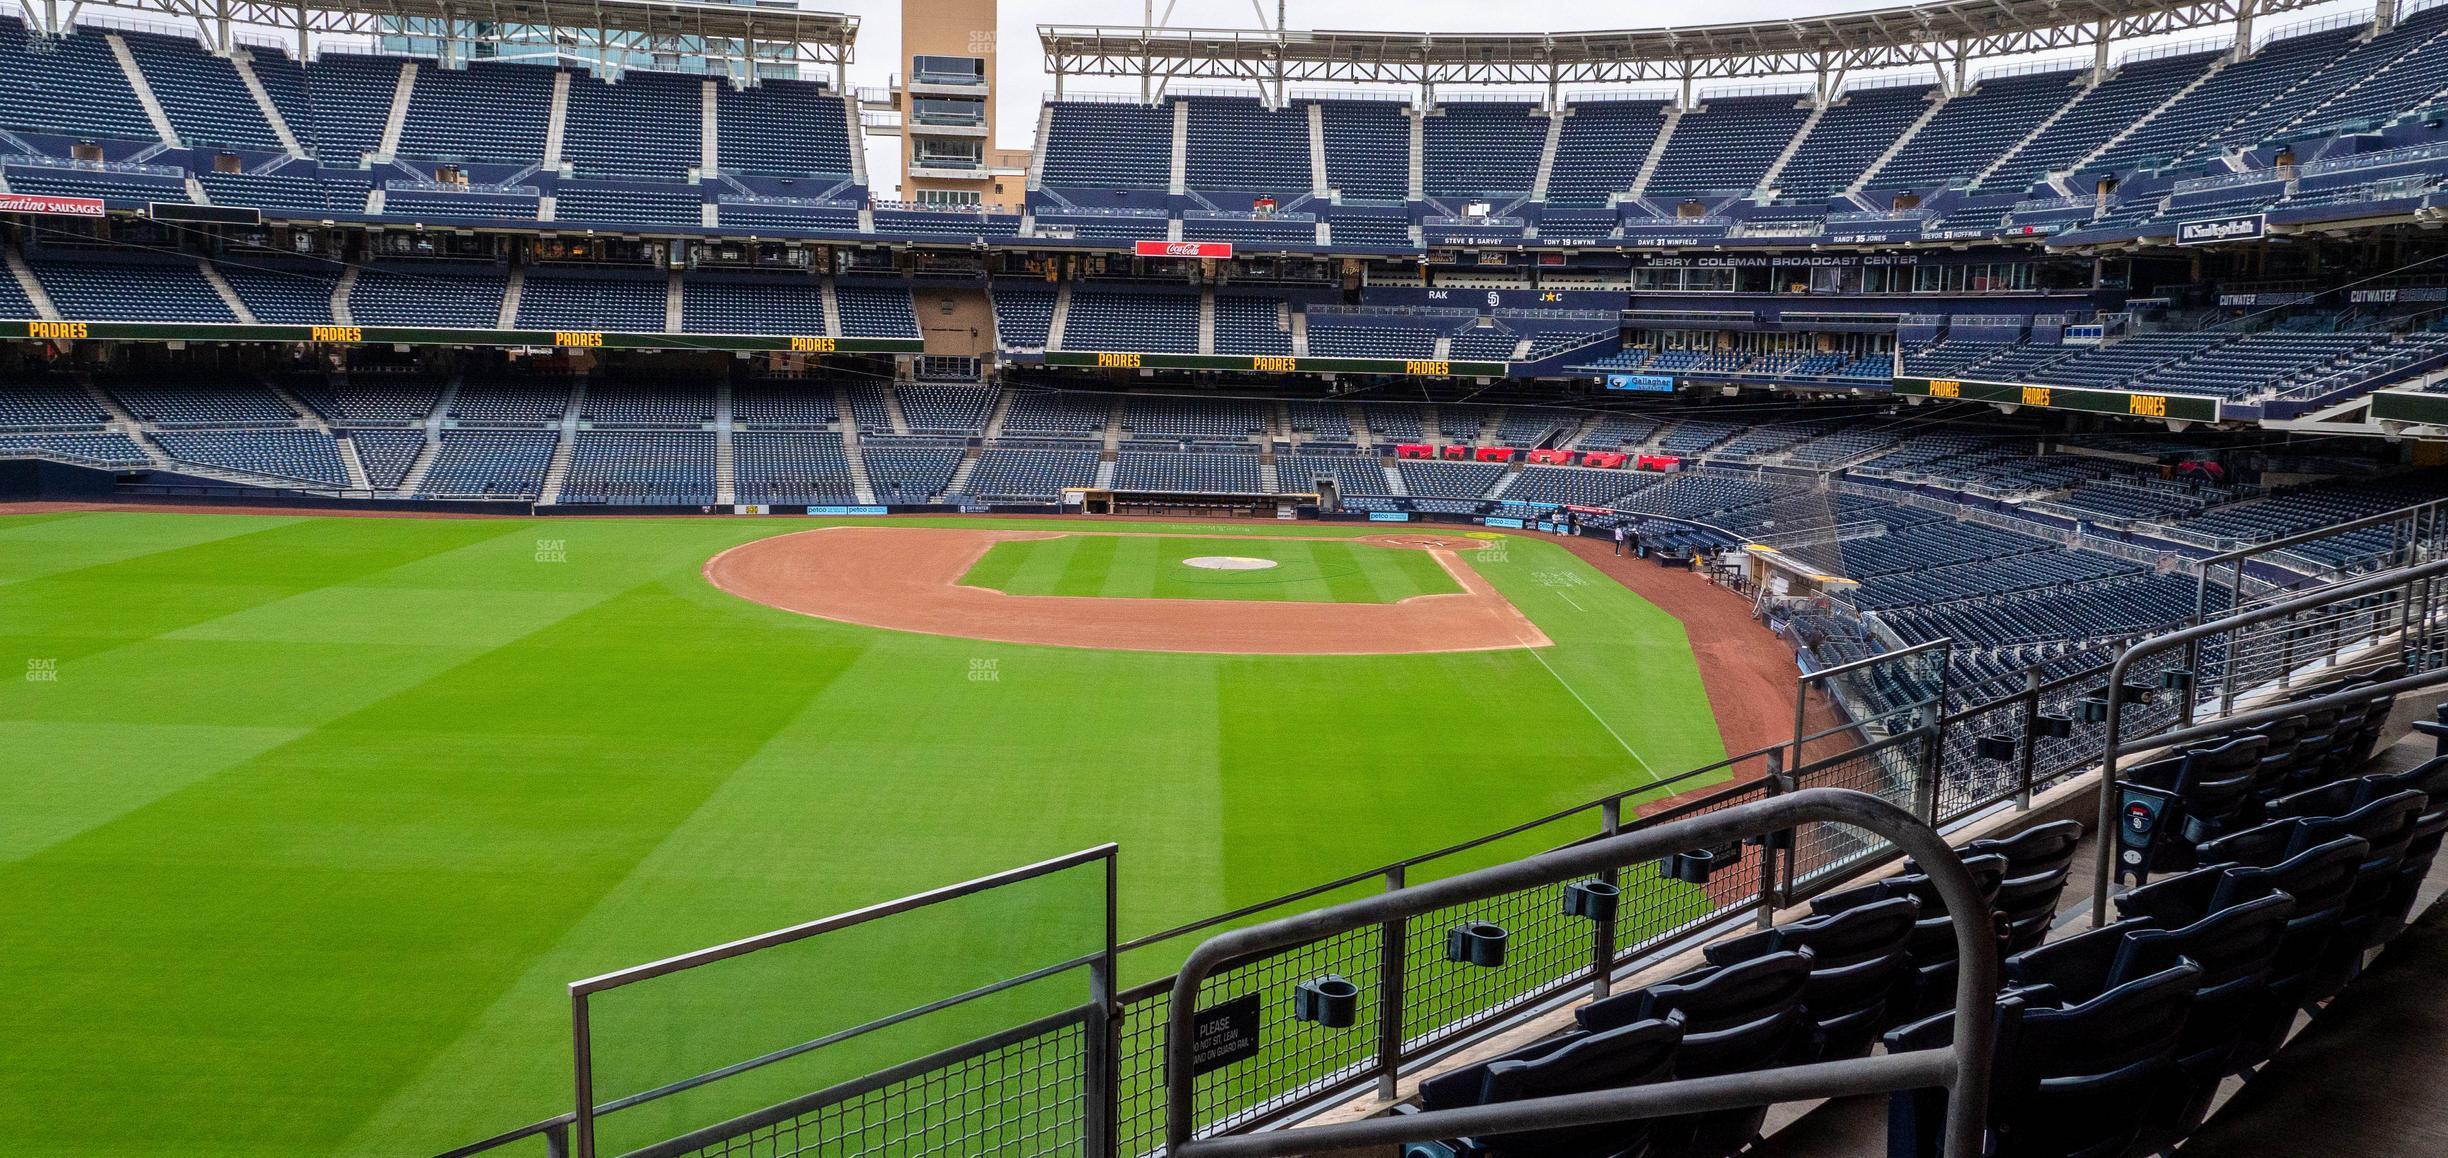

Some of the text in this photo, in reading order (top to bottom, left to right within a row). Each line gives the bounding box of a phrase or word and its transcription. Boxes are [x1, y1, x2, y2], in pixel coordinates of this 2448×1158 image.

[48, 203, 103, 214] SAUSAGES
[1855, 235, 1865, 243] 35
[1944, 231, 1952, 239] 51
[1468, 237, 1474, 245] 6
[1563, 238, 1571, 246] 19
[1656, 238, 1666, 246] 31
[1648, 256, 1918, 266] JERRY COLEMAN BROADCAST CENTER
[1428, 291, 1448, 299] RAK
[2220, 295, 2256, 306] CUTWATER
[2350, 290, 2398, 302] CUTWATER
[29, 322, 87, 338] PADRES
[313, 327, 361, 342] PADRES
[556, 332, 602, 346] PADRES
[792, 337, 834, 352] PADRES
[1099, 353, 1140, 367] PADRES
[1254, 357, 1295, 371] PADRES
[1407, 361, 1448, 375] PADRES
[1632, 377, 1671, 386] Gallagher
[1930, 380, 1959, 397] PADRES
[2023, 386, 2050, 406] PADRES
[2130, 394, 2165, 416] PADRES
[808, 506, 827, 514] petco
[849, 506, 868, 514] petco
[1370, 512, 1389, 520] petco
[1486, 517, 1504, 527] petco
[1200, 1017, 1230, 1037] PLEASE
[1201, 1038, 1212, 1050] NOT
[1223, 1029, 1239, 1042] LEAN
[1208, 1049, 1216, 1060] ON
[1217, 1042, 1237, 1057] GUARD
